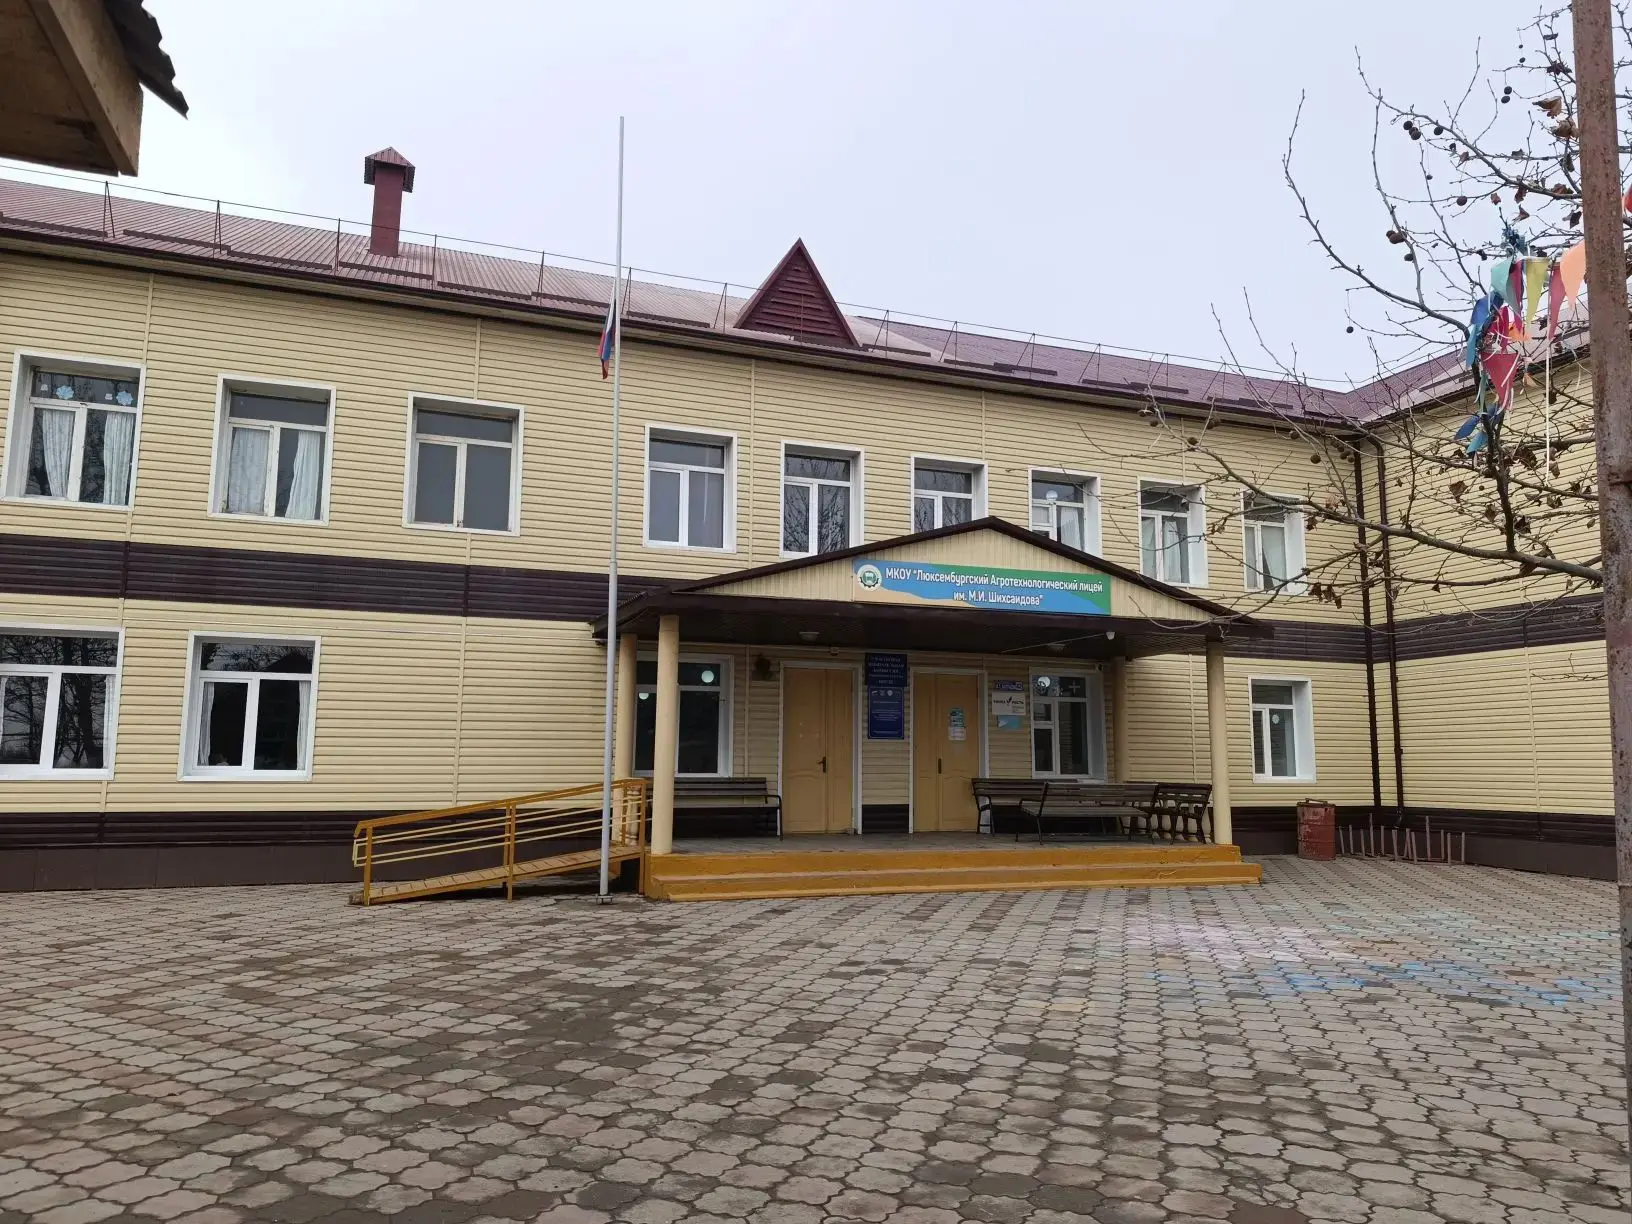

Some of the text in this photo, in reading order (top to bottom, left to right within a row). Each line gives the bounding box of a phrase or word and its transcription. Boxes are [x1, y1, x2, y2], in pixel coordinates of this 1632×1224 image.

[885, 567, 1103, 593] МКОУ "Люксембургский Агротехнологический лицей
[953, 591, 967, 601] им.
